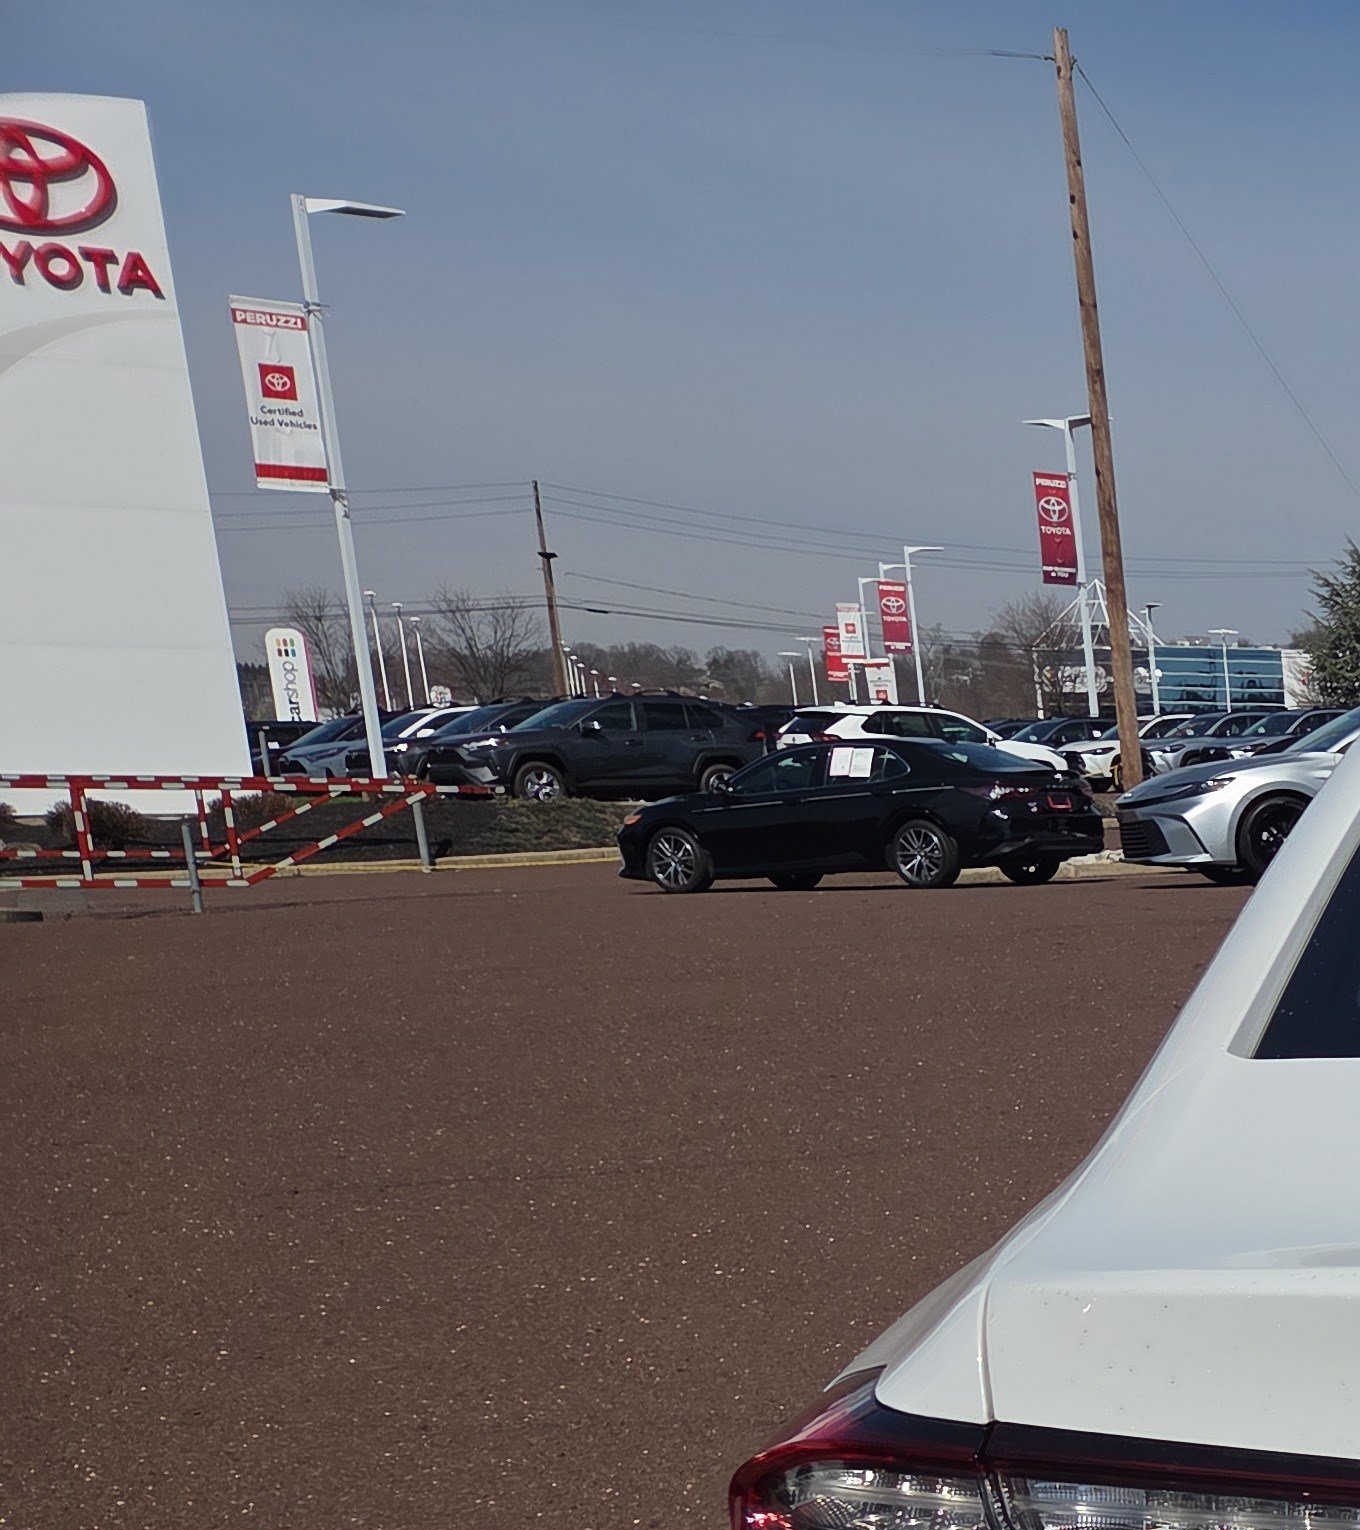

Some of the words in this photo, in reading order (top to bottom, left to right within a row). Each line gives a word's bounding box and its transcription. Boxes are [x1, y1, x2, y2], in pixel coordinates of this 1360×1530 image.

[235, 310, 303, 329] PERUZZI
[260, 405, 304, 418] Certified
[250, 416, 275, 427] Used
[277, 418, 318, 430] Vehicles
[1041, 525, 1072, 536] TOYOTA
